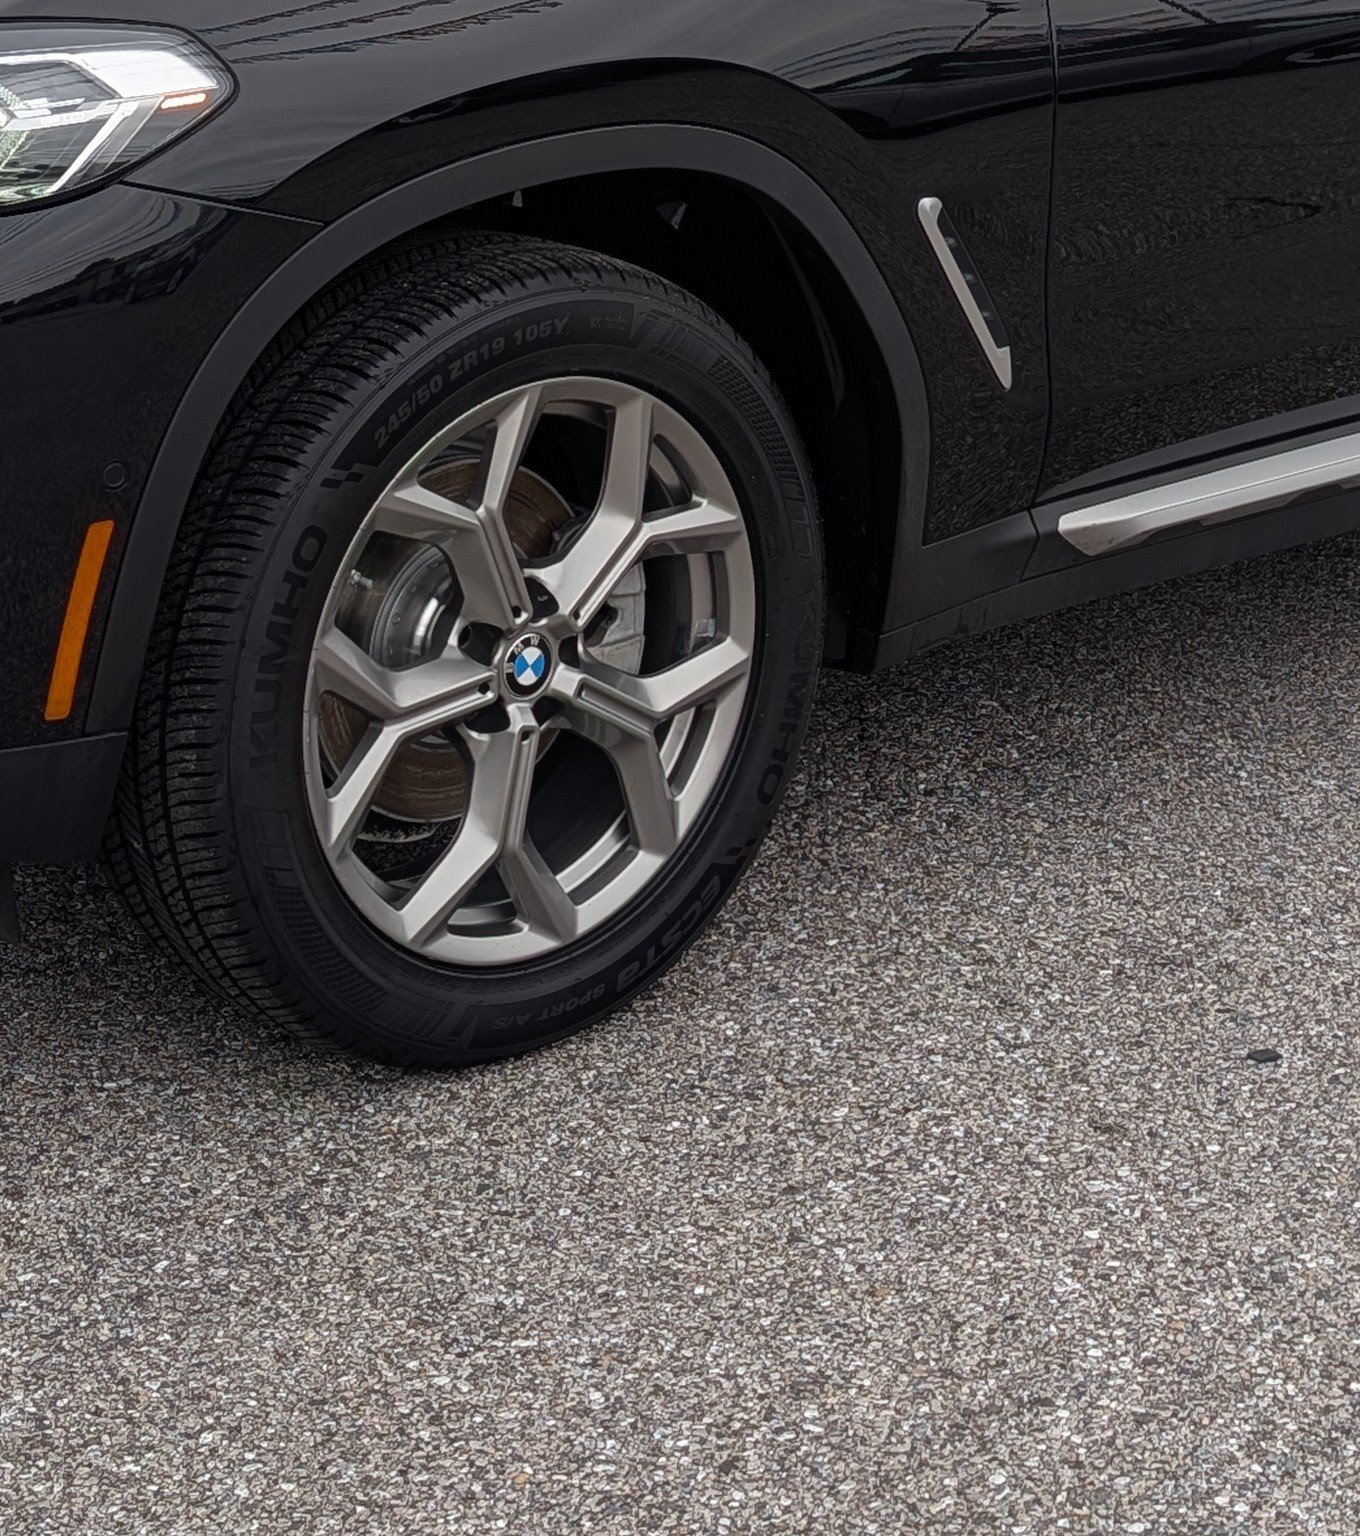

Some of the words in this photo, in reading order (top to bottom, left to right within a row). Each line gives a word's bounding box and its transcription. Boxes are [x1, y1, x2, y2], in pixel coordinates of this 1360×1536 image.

[373, 373, 444, 451] 245/50
[448, 336, 506, 380] ZR19
[248, 524, 328, 770] KUMHO
[504, 633, 541, 674] BMW
[536, 982, 607, 1023] SPORT
